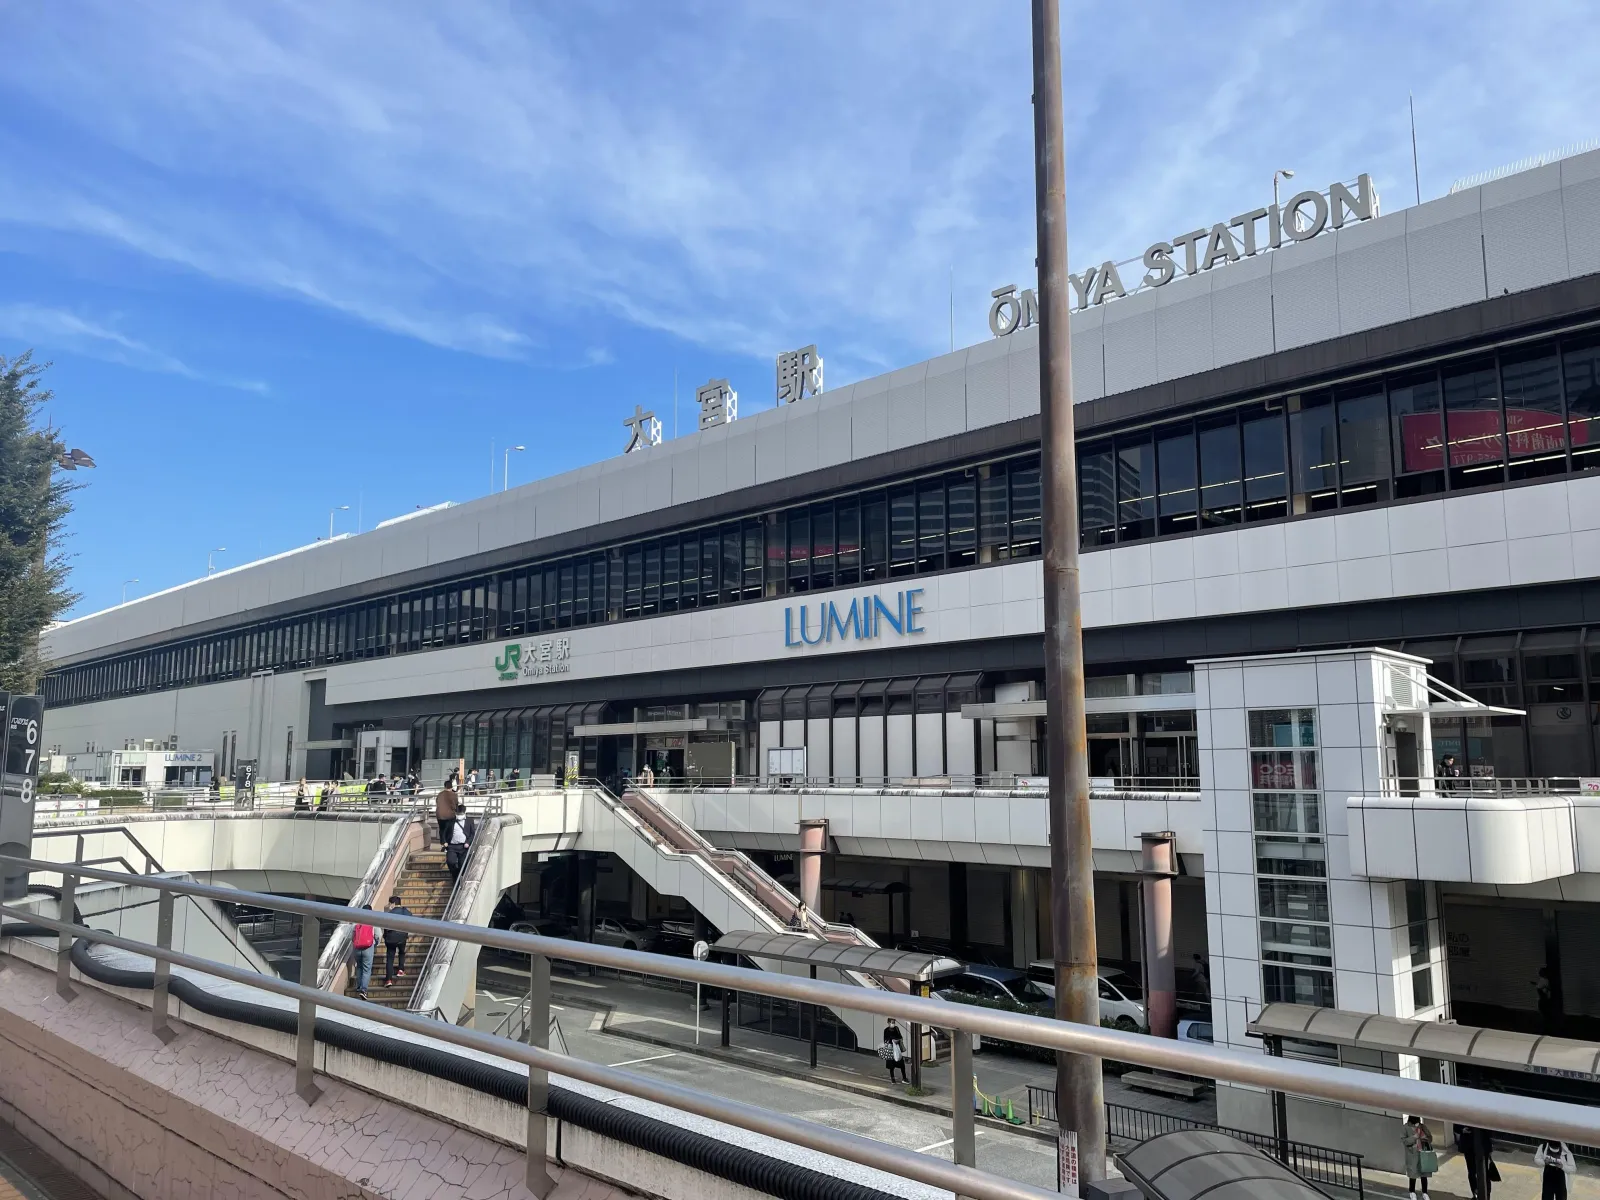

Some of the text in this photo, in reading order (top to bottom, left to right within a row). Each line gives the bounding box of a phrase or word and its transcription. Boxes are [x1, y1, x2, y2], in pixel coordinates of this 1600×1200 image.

[988, 173, 1375, 336] ŌMYA STATION
[623, 344, 818, 454] 大宮駅
[784, 588, 925, 648] LUMINE
[495, 643, 521, 672] JR
[524, 637, 571, 664] 大宮駅
[545, 662, 570, 674] Station
[26, 719, 38, 745] 6
[25, 749, 36, 774] 7
[165, 753, 203, 763] LUMINE 2
[245, 765, 252, 773] 6
[21, 778, 33, 804] 8
[244, 780, 251, 788] 8
